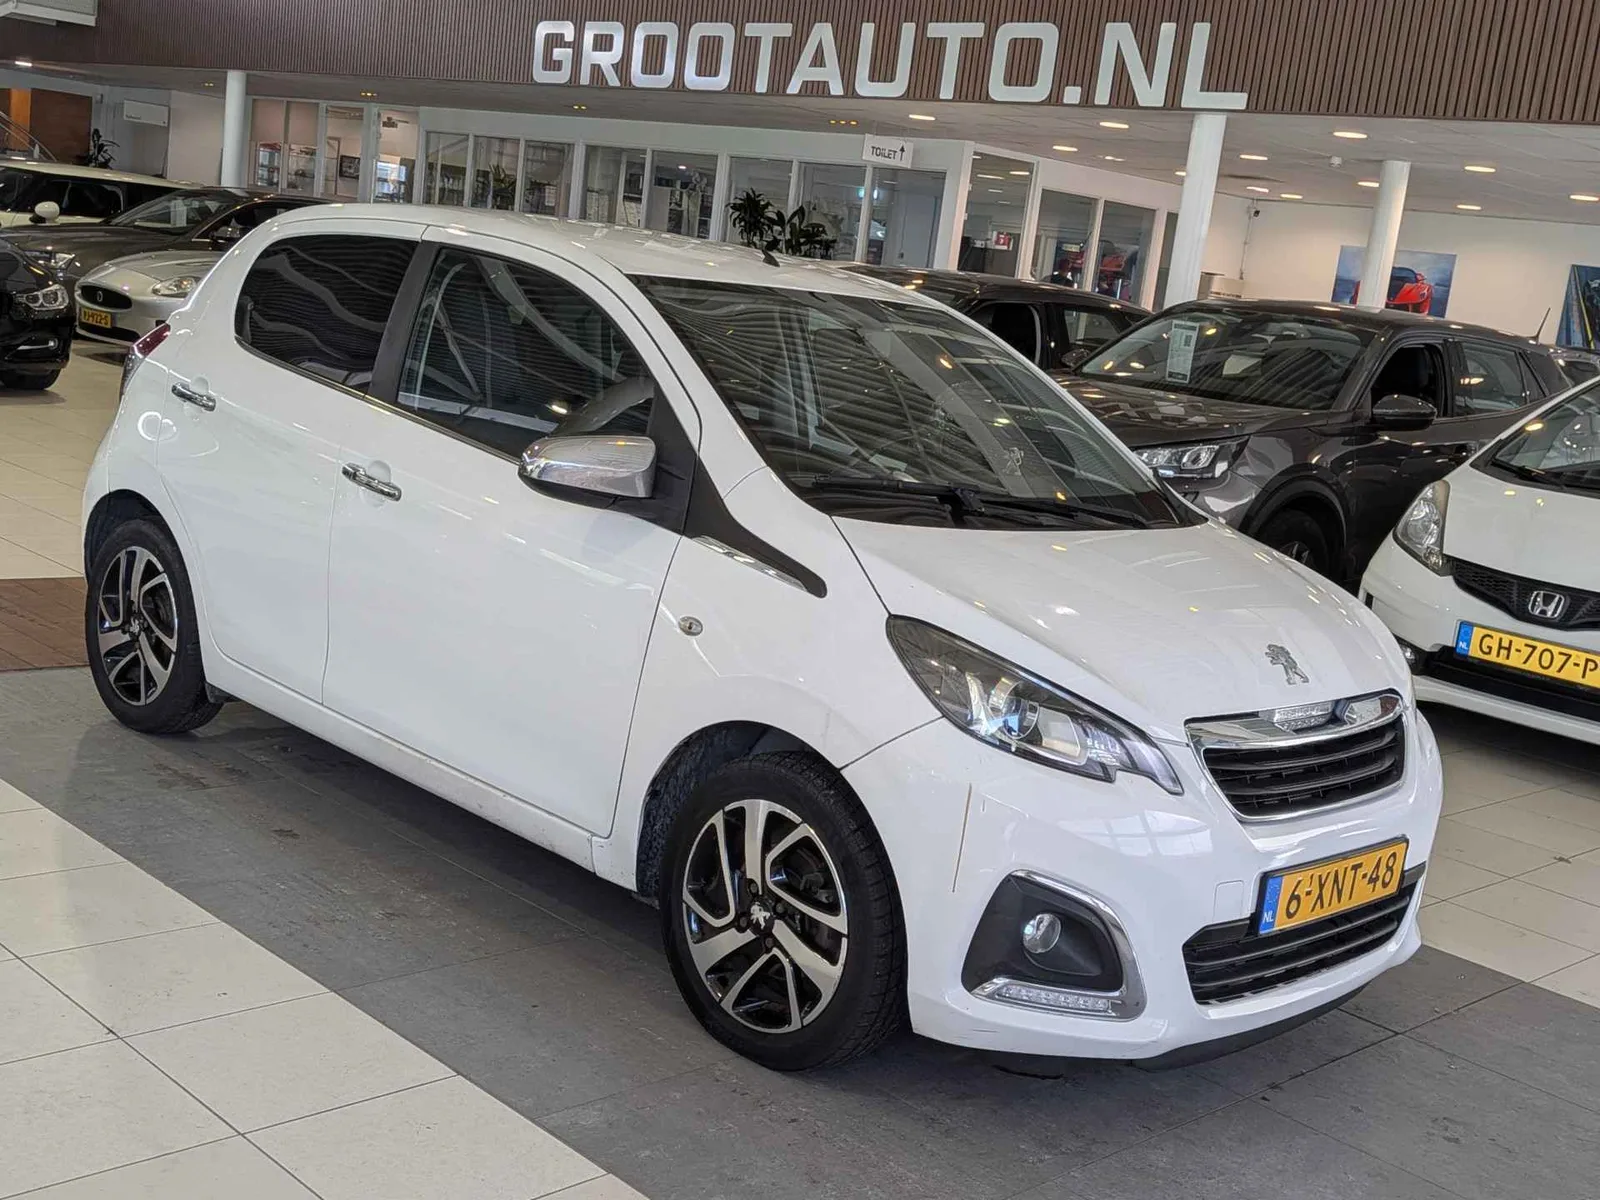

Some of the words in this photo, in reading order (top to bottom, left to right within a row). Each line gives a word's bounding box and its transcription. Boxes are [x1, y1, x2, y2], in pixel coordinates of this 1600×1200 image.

[532, 20, 1249, 111] GROOTAUTO.NL
[870, 145, 898, 160] TOILET
[1459, 641, 1468, 650] NL
[1478, 633, 1599, 679] GH-707-P
[1285, 851, 1398, 920] 6-XNT-48
[1263, 911, 1274, 923] NL
